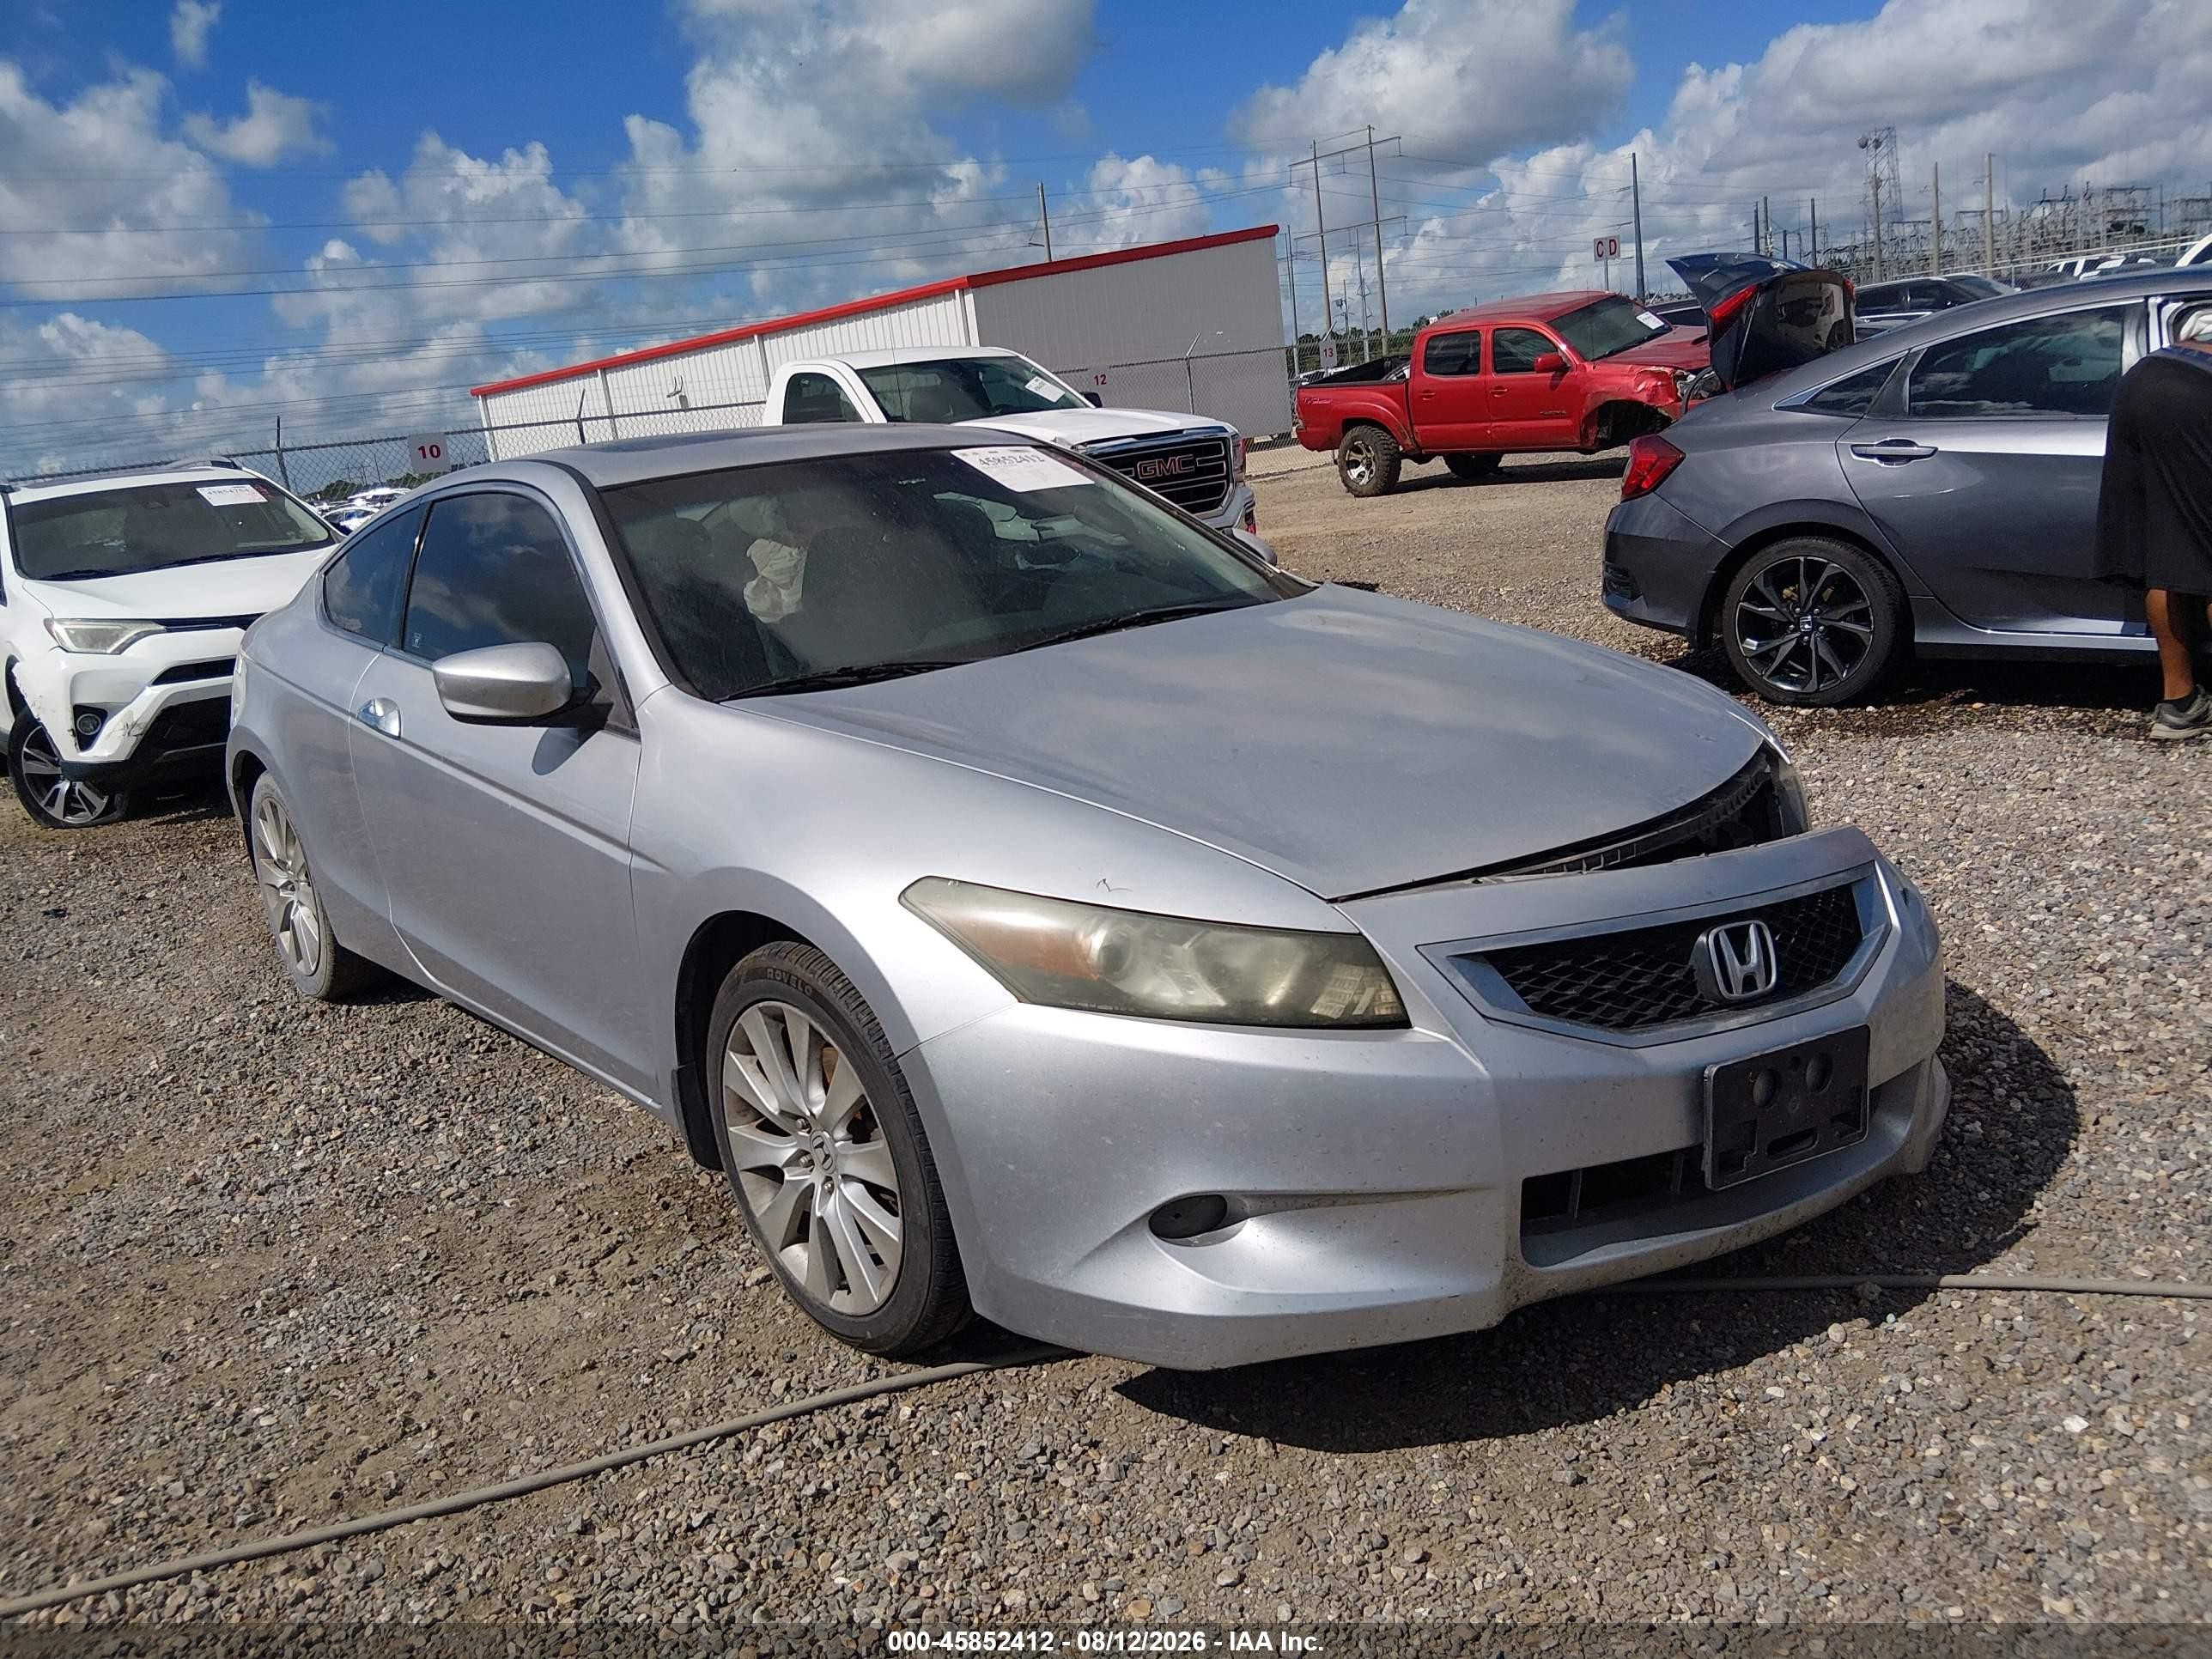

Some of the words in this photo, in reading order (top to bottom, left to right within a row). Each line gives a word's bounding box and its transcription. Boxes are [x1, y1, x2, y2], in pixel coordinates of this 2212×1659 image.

[1596, 240, 1604, 258] C
[1609, 239, 1617, 256] D
[1323, 347, 1334, 358] 13
[1094, 374, 1107, 386] 12
[418, 444, 441, 459] 10
[1137, 453, 1195, 479] GMC
[766, 968, 813, 995] ROVELO
